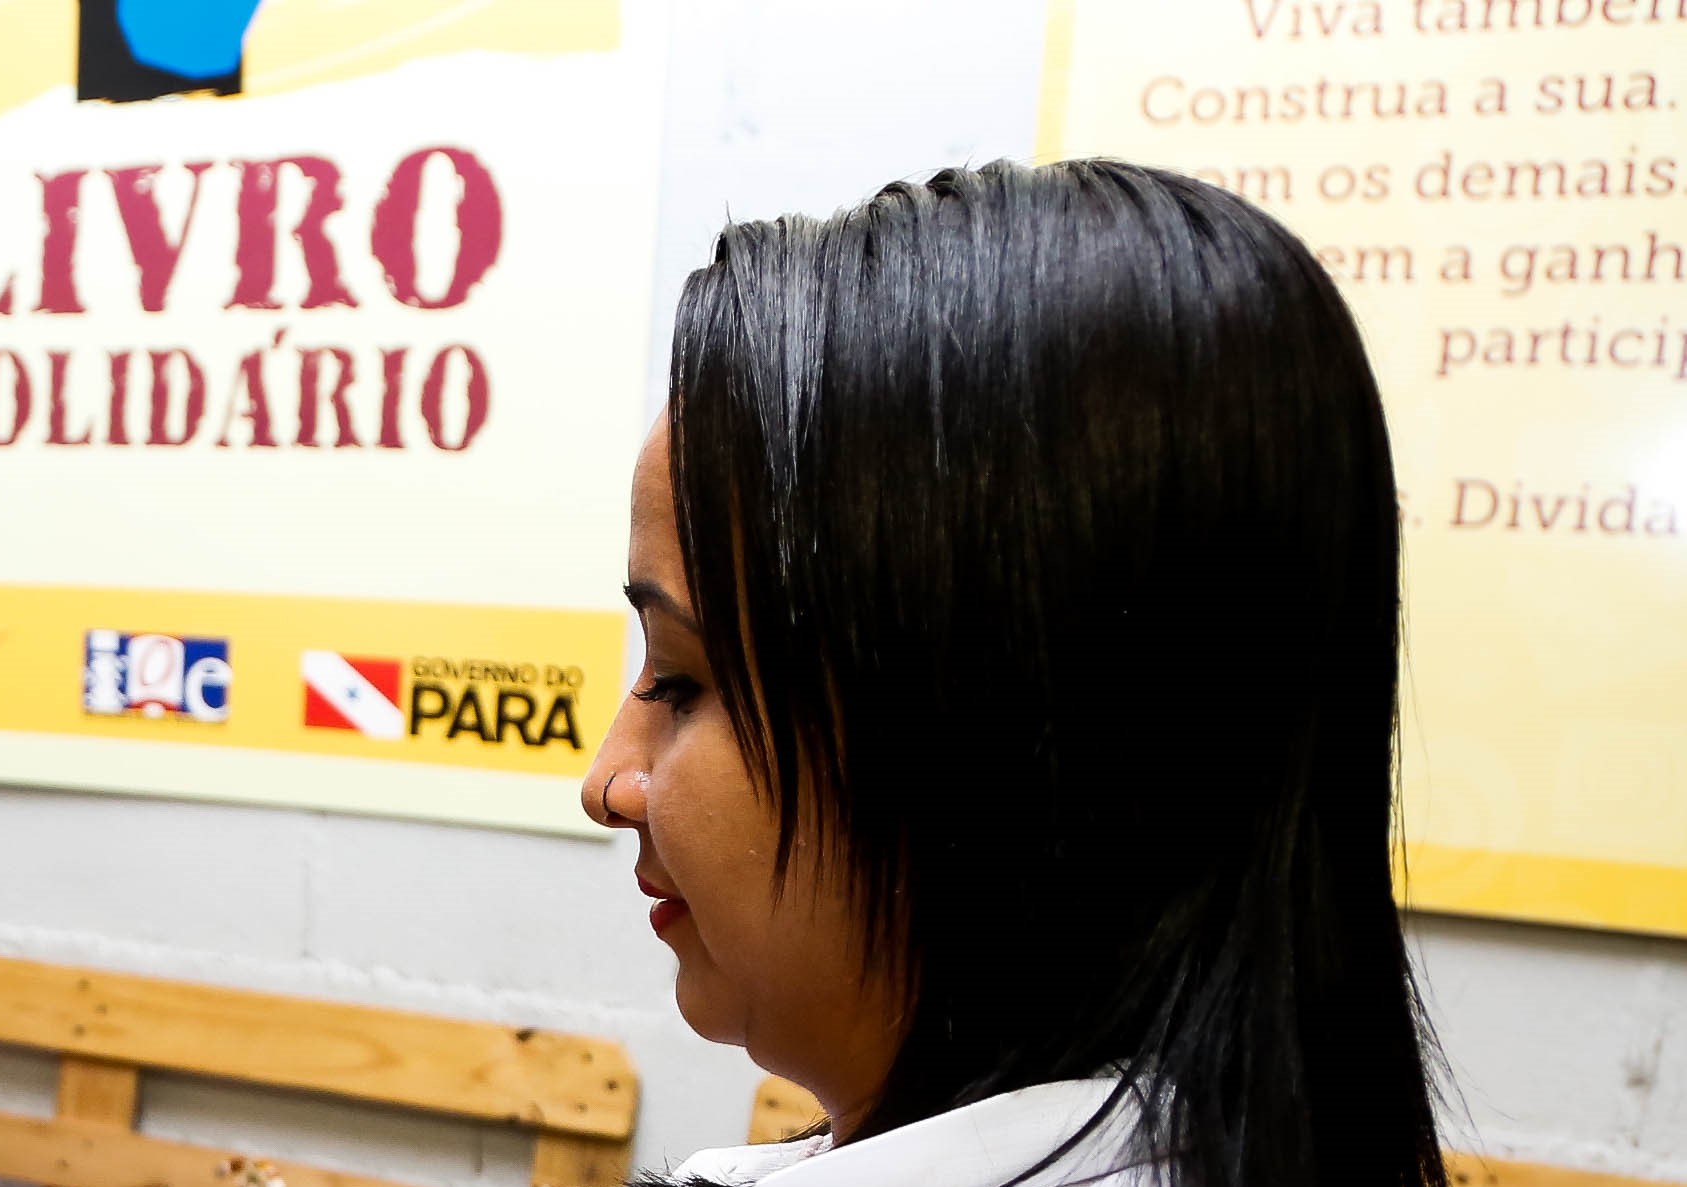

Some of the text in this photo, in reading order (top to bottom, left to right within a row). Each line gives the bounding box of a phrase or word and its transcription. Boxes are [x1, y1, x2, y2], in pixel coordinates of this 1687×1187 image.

[1140, 70, 1679, 127] Construa a sua.
[1317, 163, 1392, 204] os
[1439, 244, 1473, 283] a
[1435, 315, 1687, 380] partici
[1450, 477, 1679, 537] Divida
[411, 654, 584, 688] GOVERNO DO
